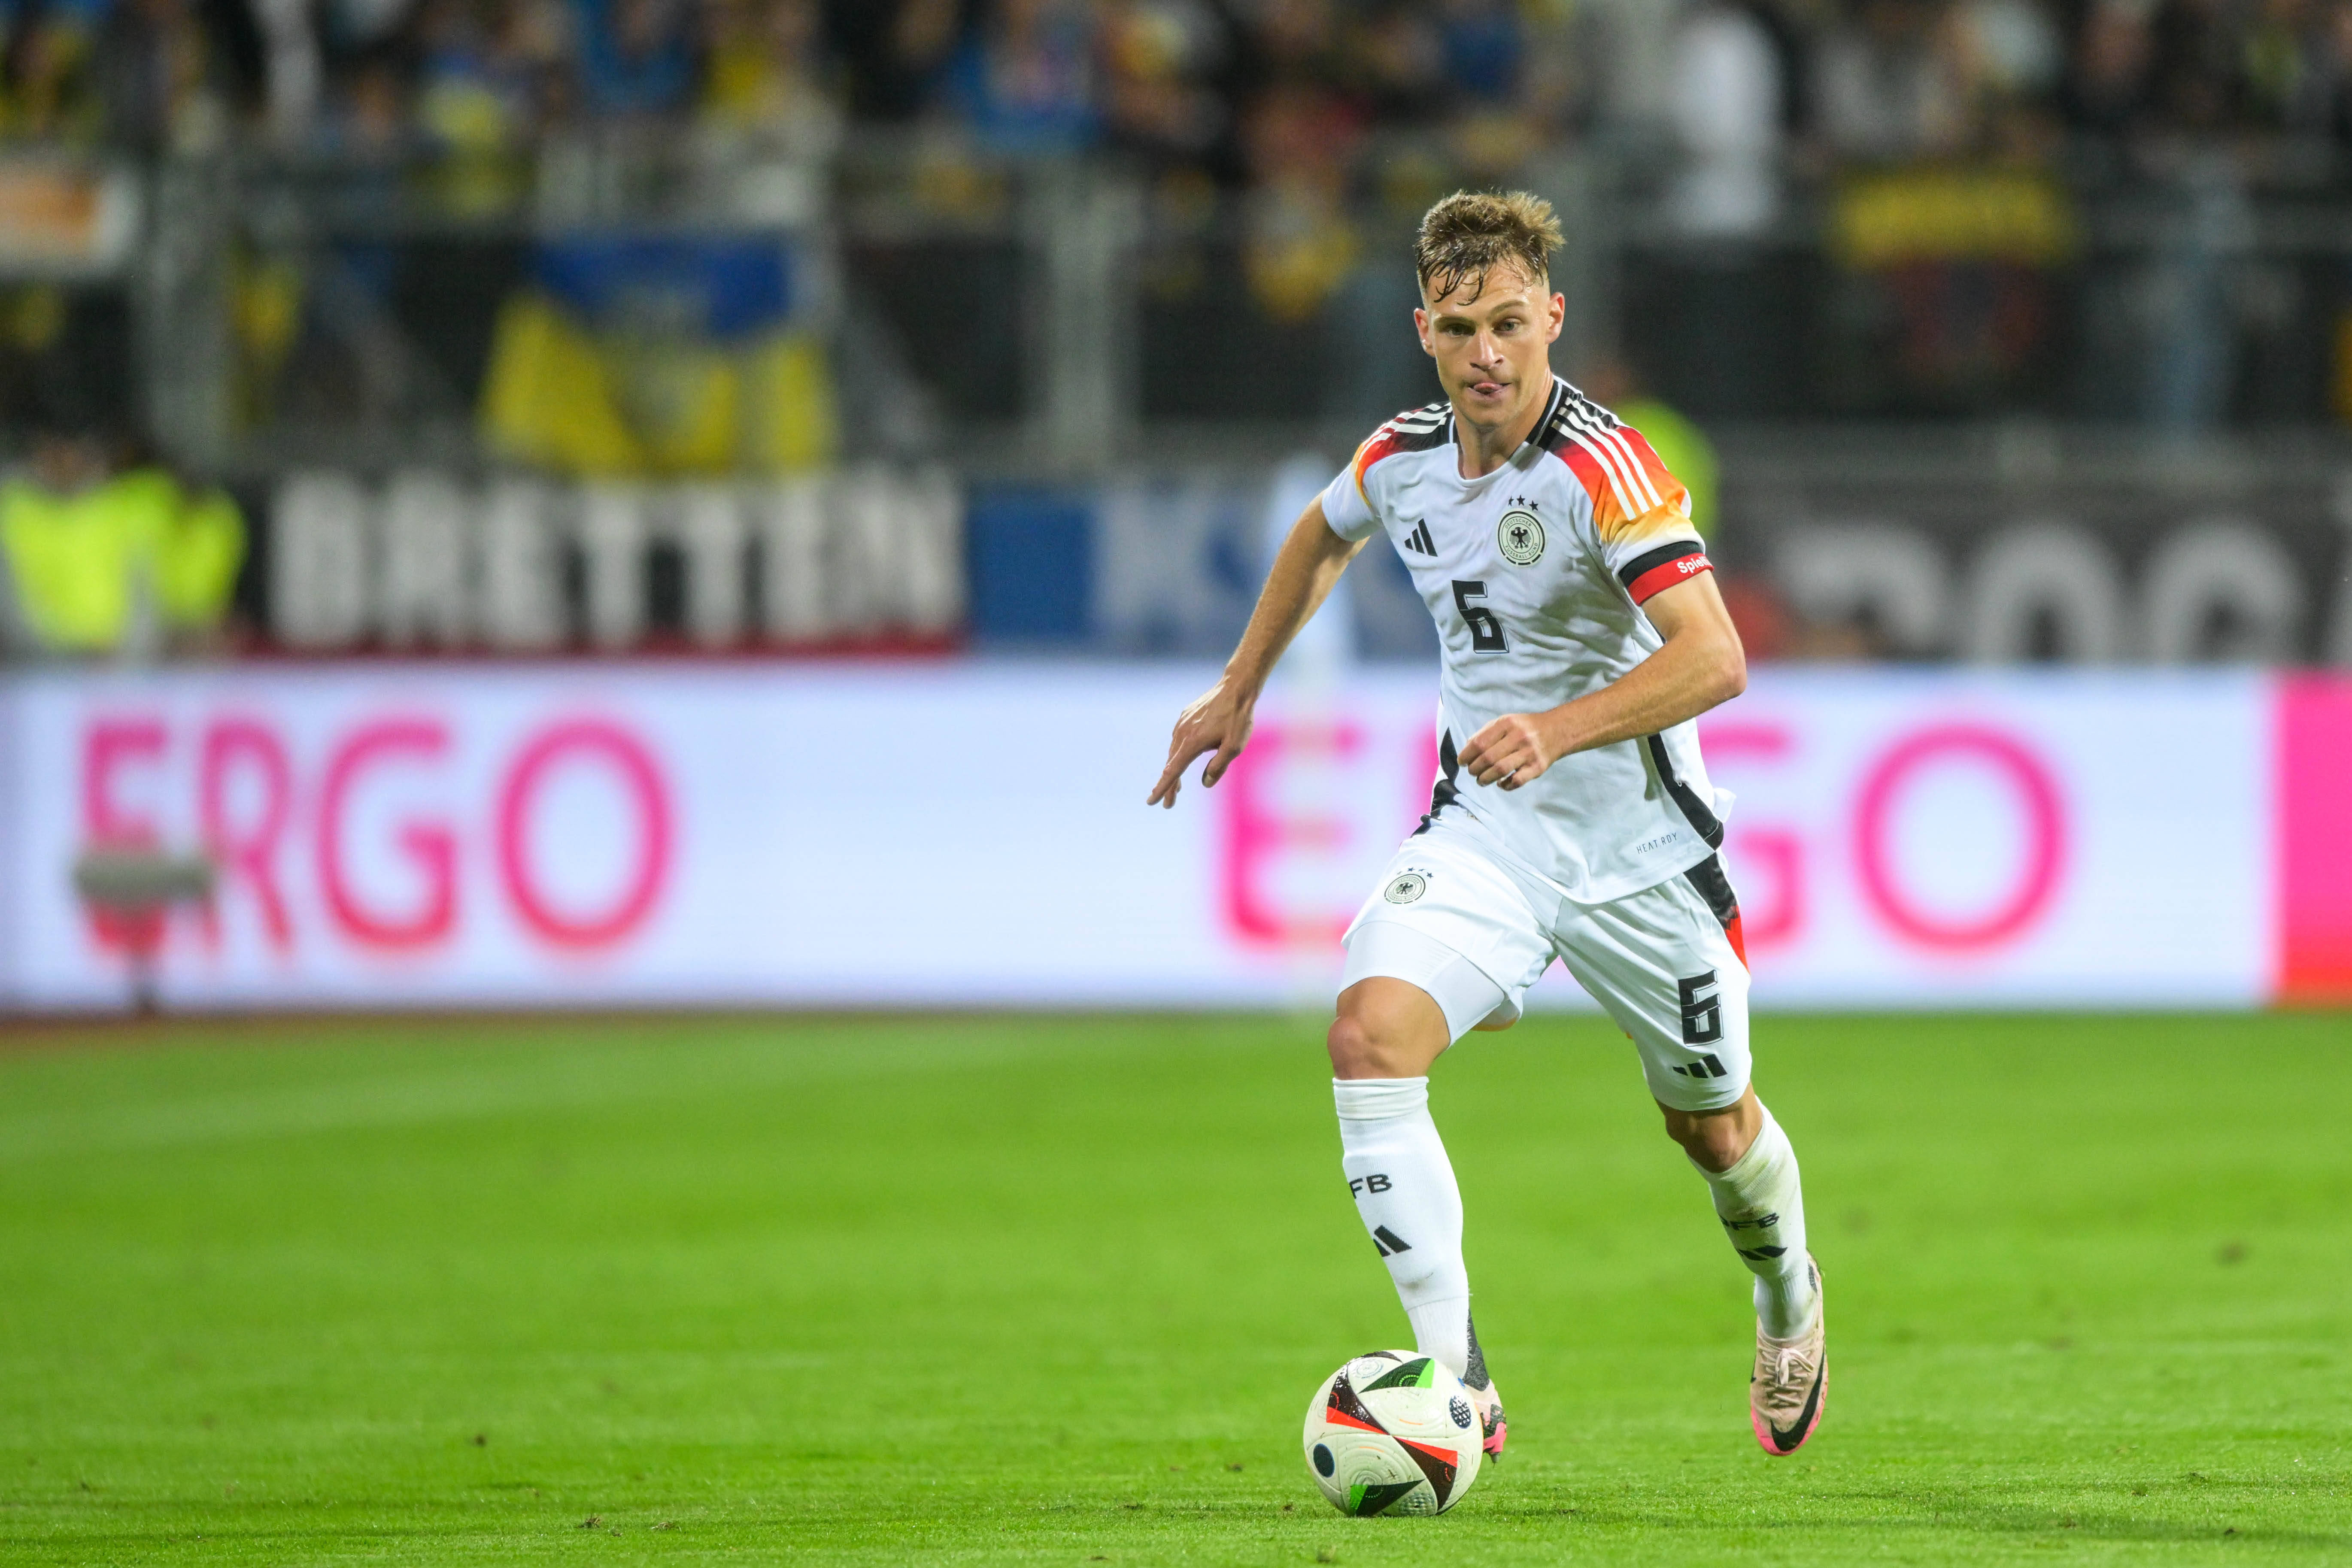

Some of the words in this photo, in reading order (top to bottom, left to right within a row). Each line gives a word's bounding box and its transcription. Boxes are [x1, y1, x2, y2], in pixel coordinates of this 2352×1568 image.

[1451, 579, 1510, 654] 6
[79, 713, 678, 954] ERGO
[1678, 969, 1724, 1047] 6
